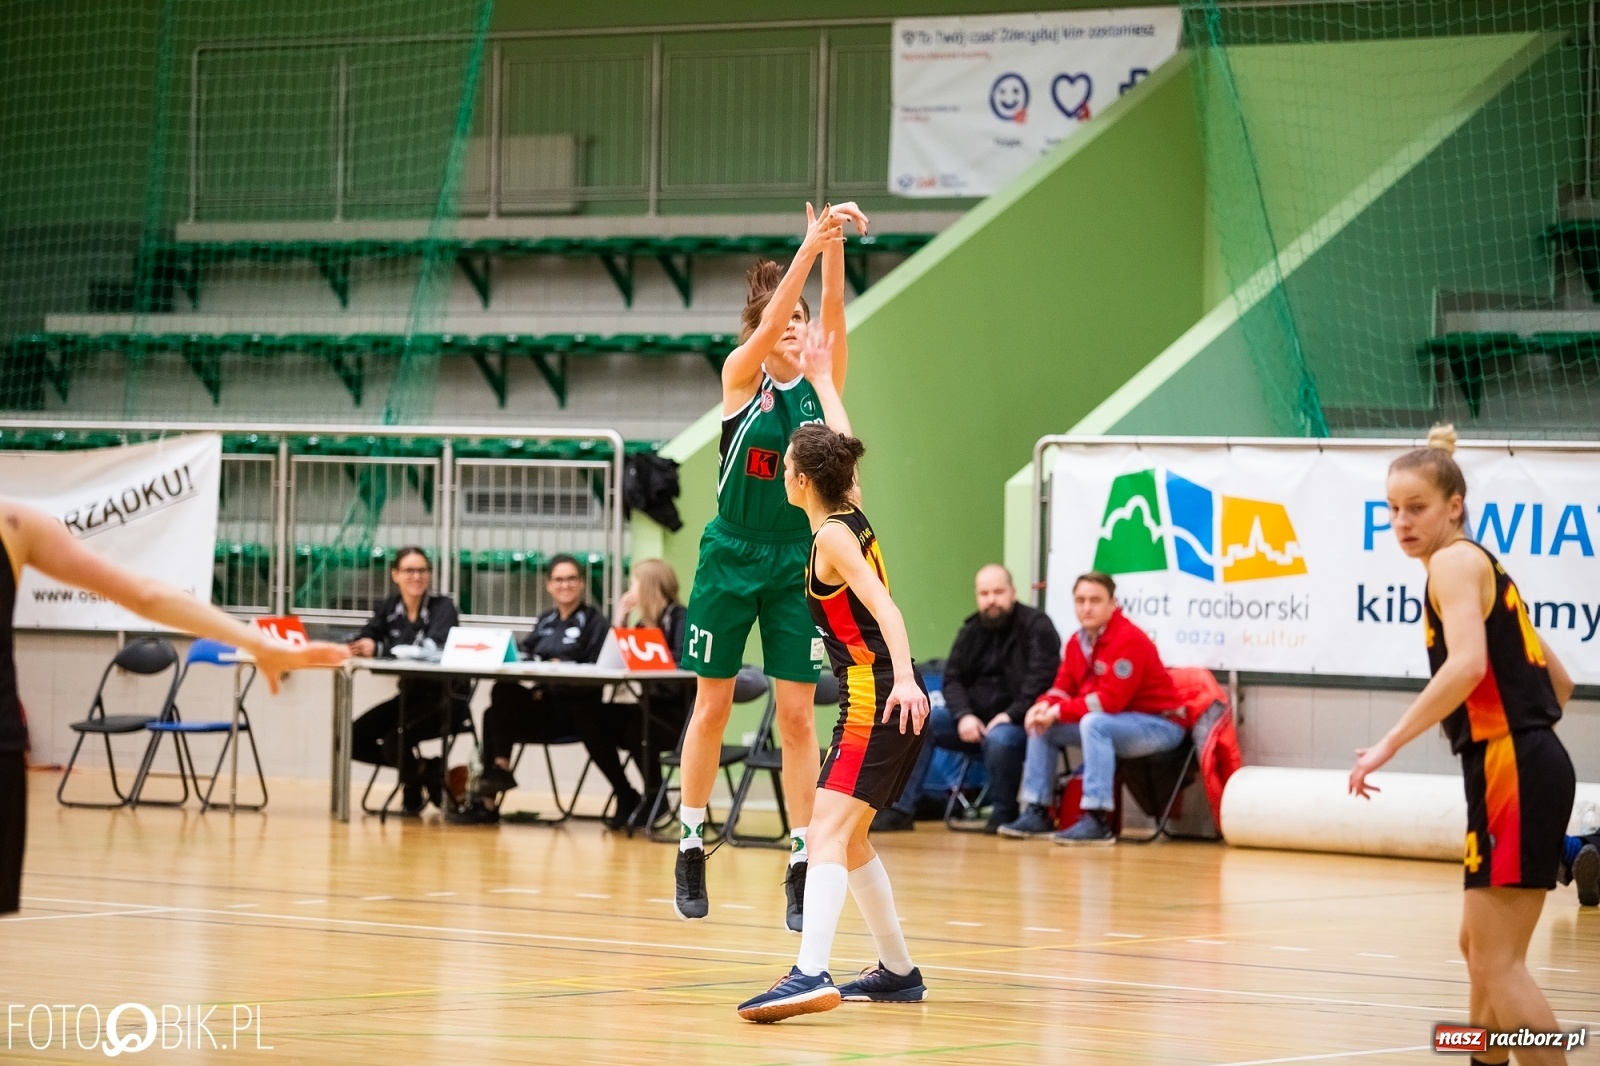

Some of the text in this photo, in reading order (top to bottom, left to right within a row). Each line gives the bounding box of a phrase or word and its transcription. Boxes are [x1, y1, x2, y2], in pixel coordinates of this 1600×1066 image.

[748, 451, 774, 476] K
[56, 464, 195, 535] RZĄDKU!
[1363, 500, 1600, 557] PWIA
[1119, 589, 1310, 622] wiat raciborski
[688, 623, 713, 664] 27
[1176, 628, 1225, 646] oaza
